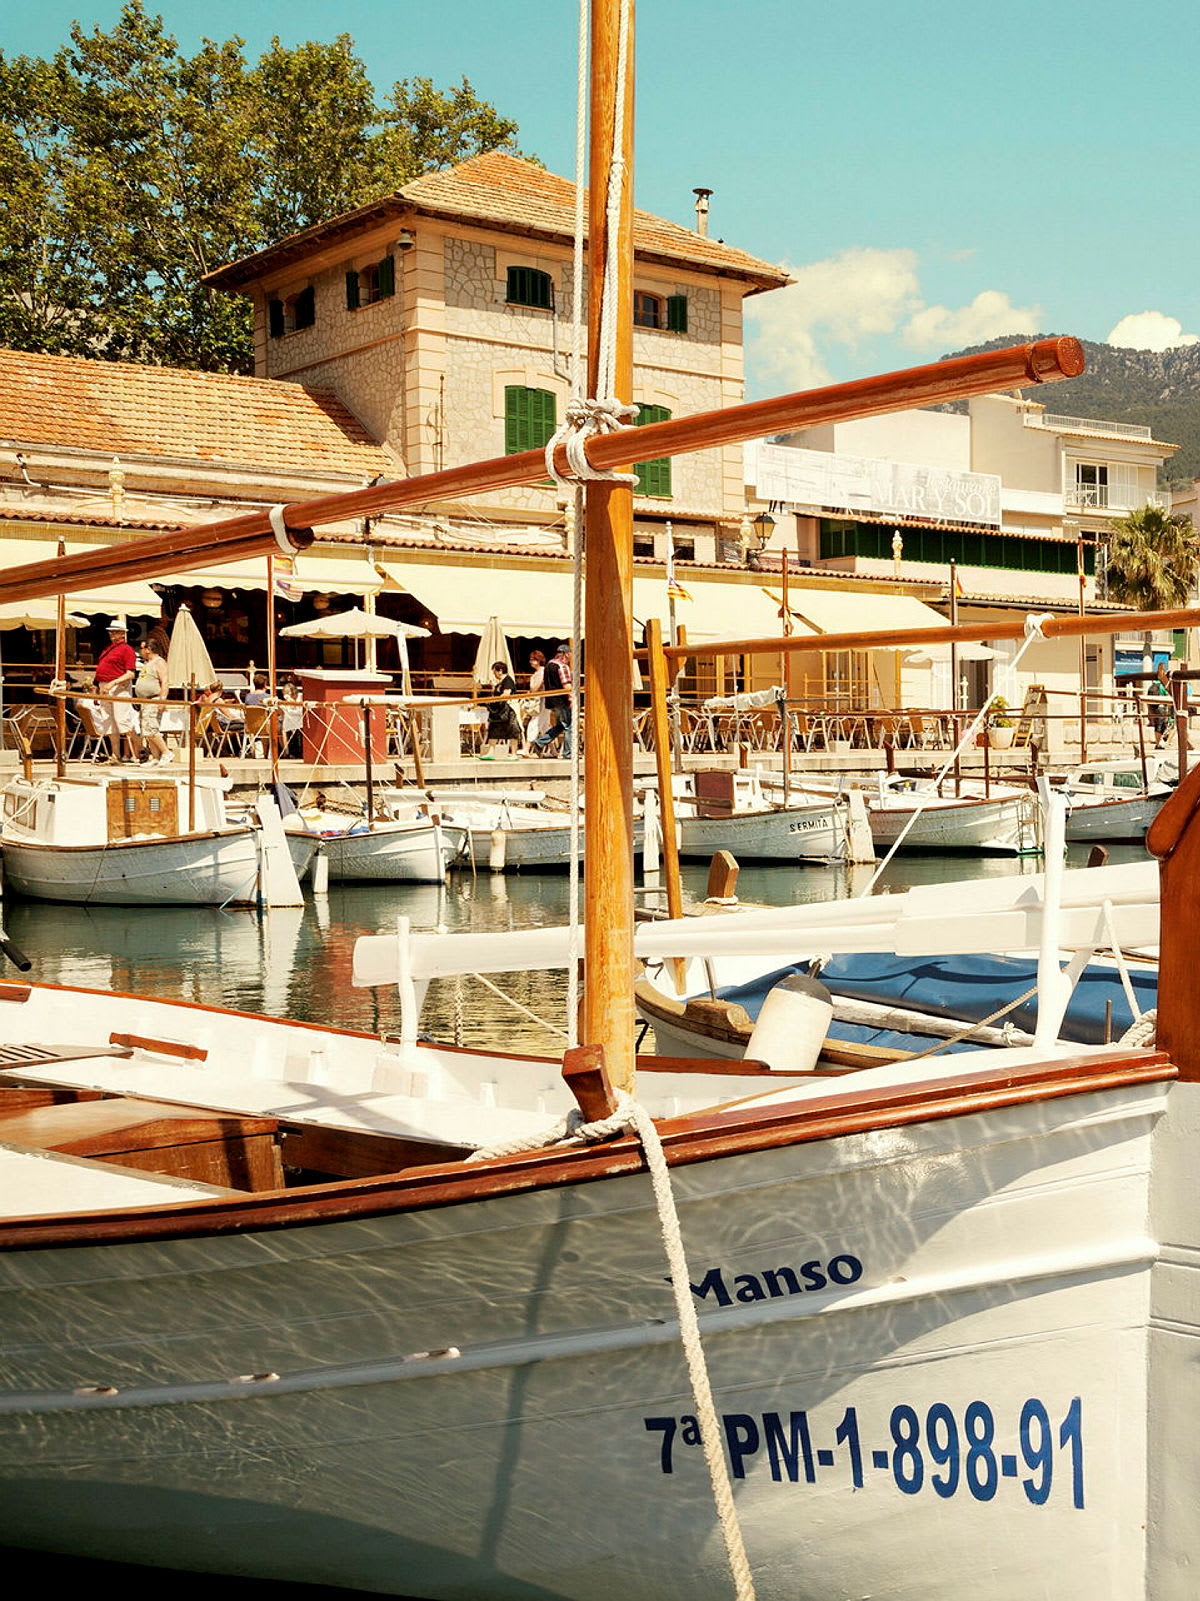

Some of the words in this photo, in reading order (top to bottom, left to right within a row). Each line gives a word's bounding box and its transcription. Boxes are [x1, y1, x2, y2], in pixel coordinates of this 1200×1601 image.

[871, 481, 928, 511] MAR
[934, 488, 949, 513] Y
[954, 492, 998, 518] SOL
[664, 1254, 864, 1308] Manso
[722, 1396, 1086, 1511] PM-1-898-91
